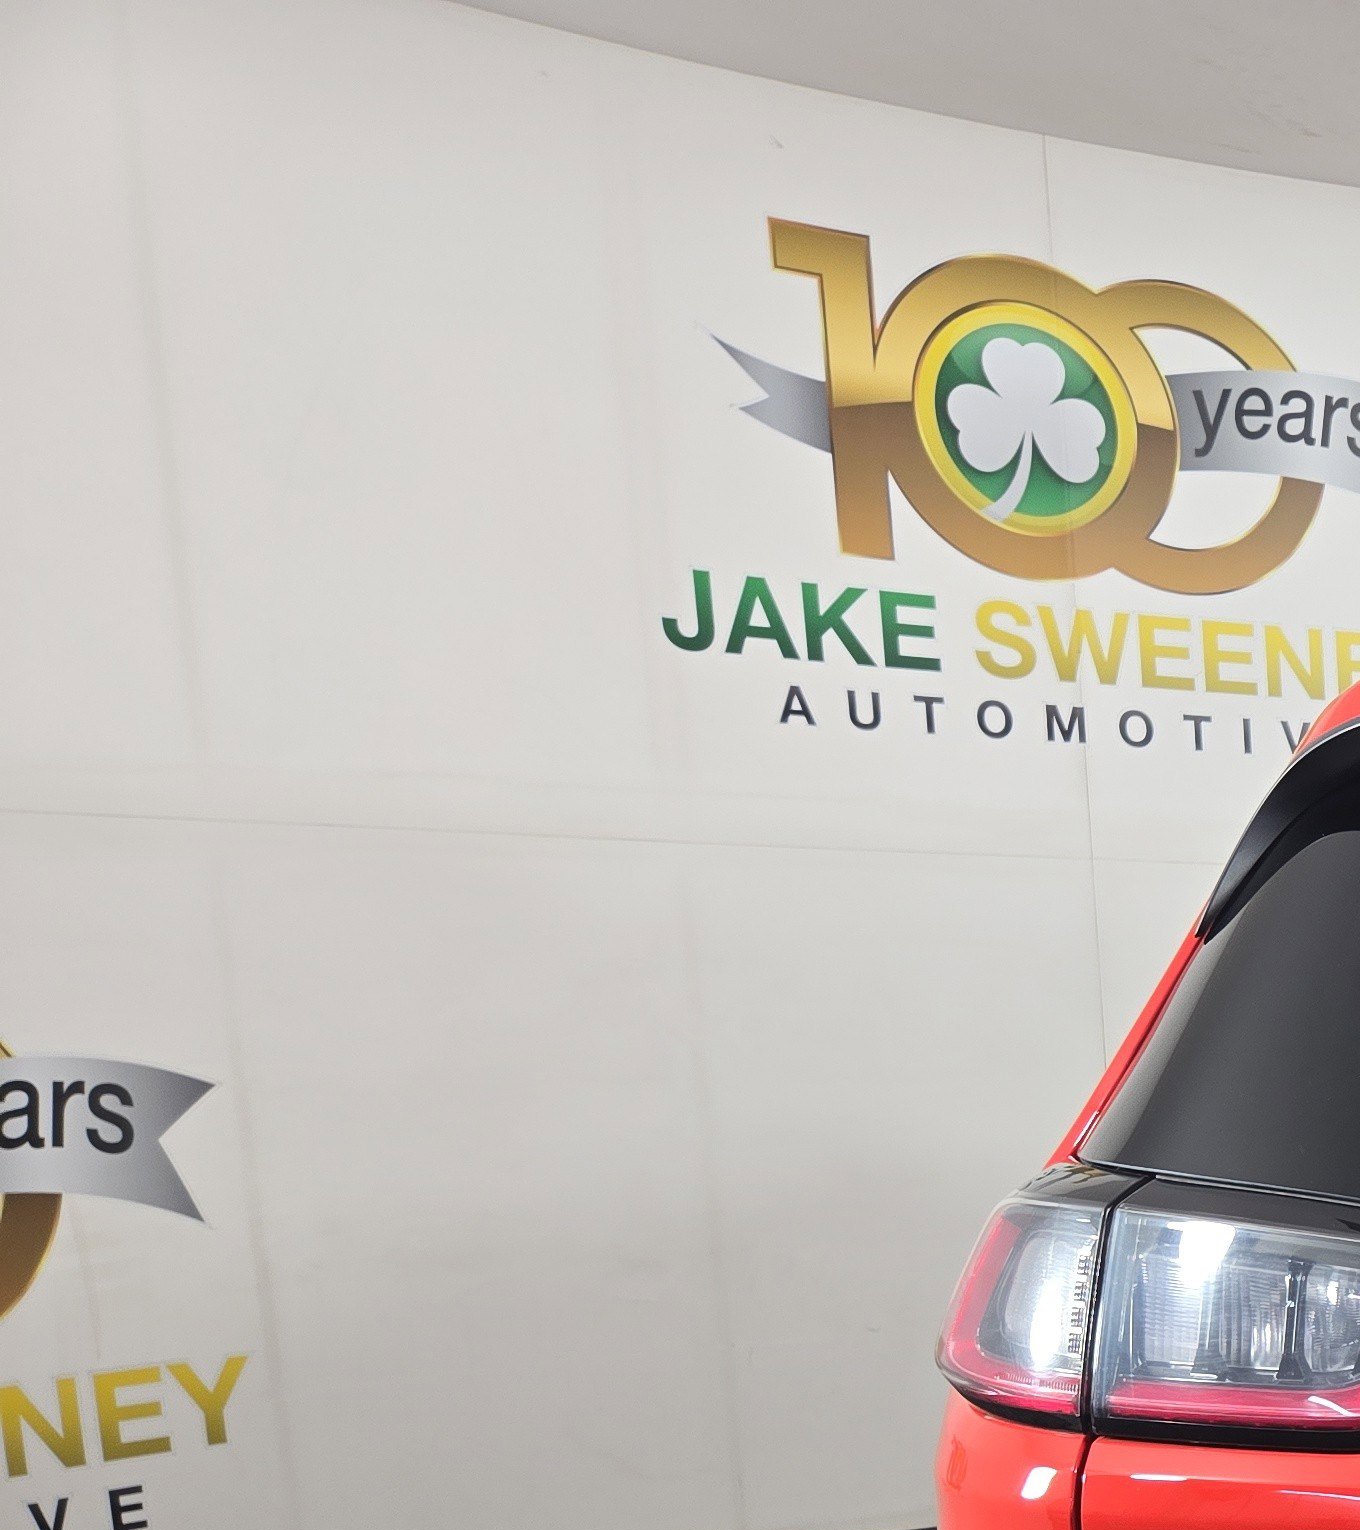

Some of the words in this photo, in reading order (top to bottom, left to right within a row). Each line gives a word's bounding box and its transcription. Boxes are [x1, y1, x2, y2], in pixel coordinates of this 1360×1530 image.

[768, 217, 1326, 596] 100
[661, 568, 942, 673] JAKE
[779, 685, 1311, 755] AUTOMOTIV
[0, 1079, 135, 1154] ars
